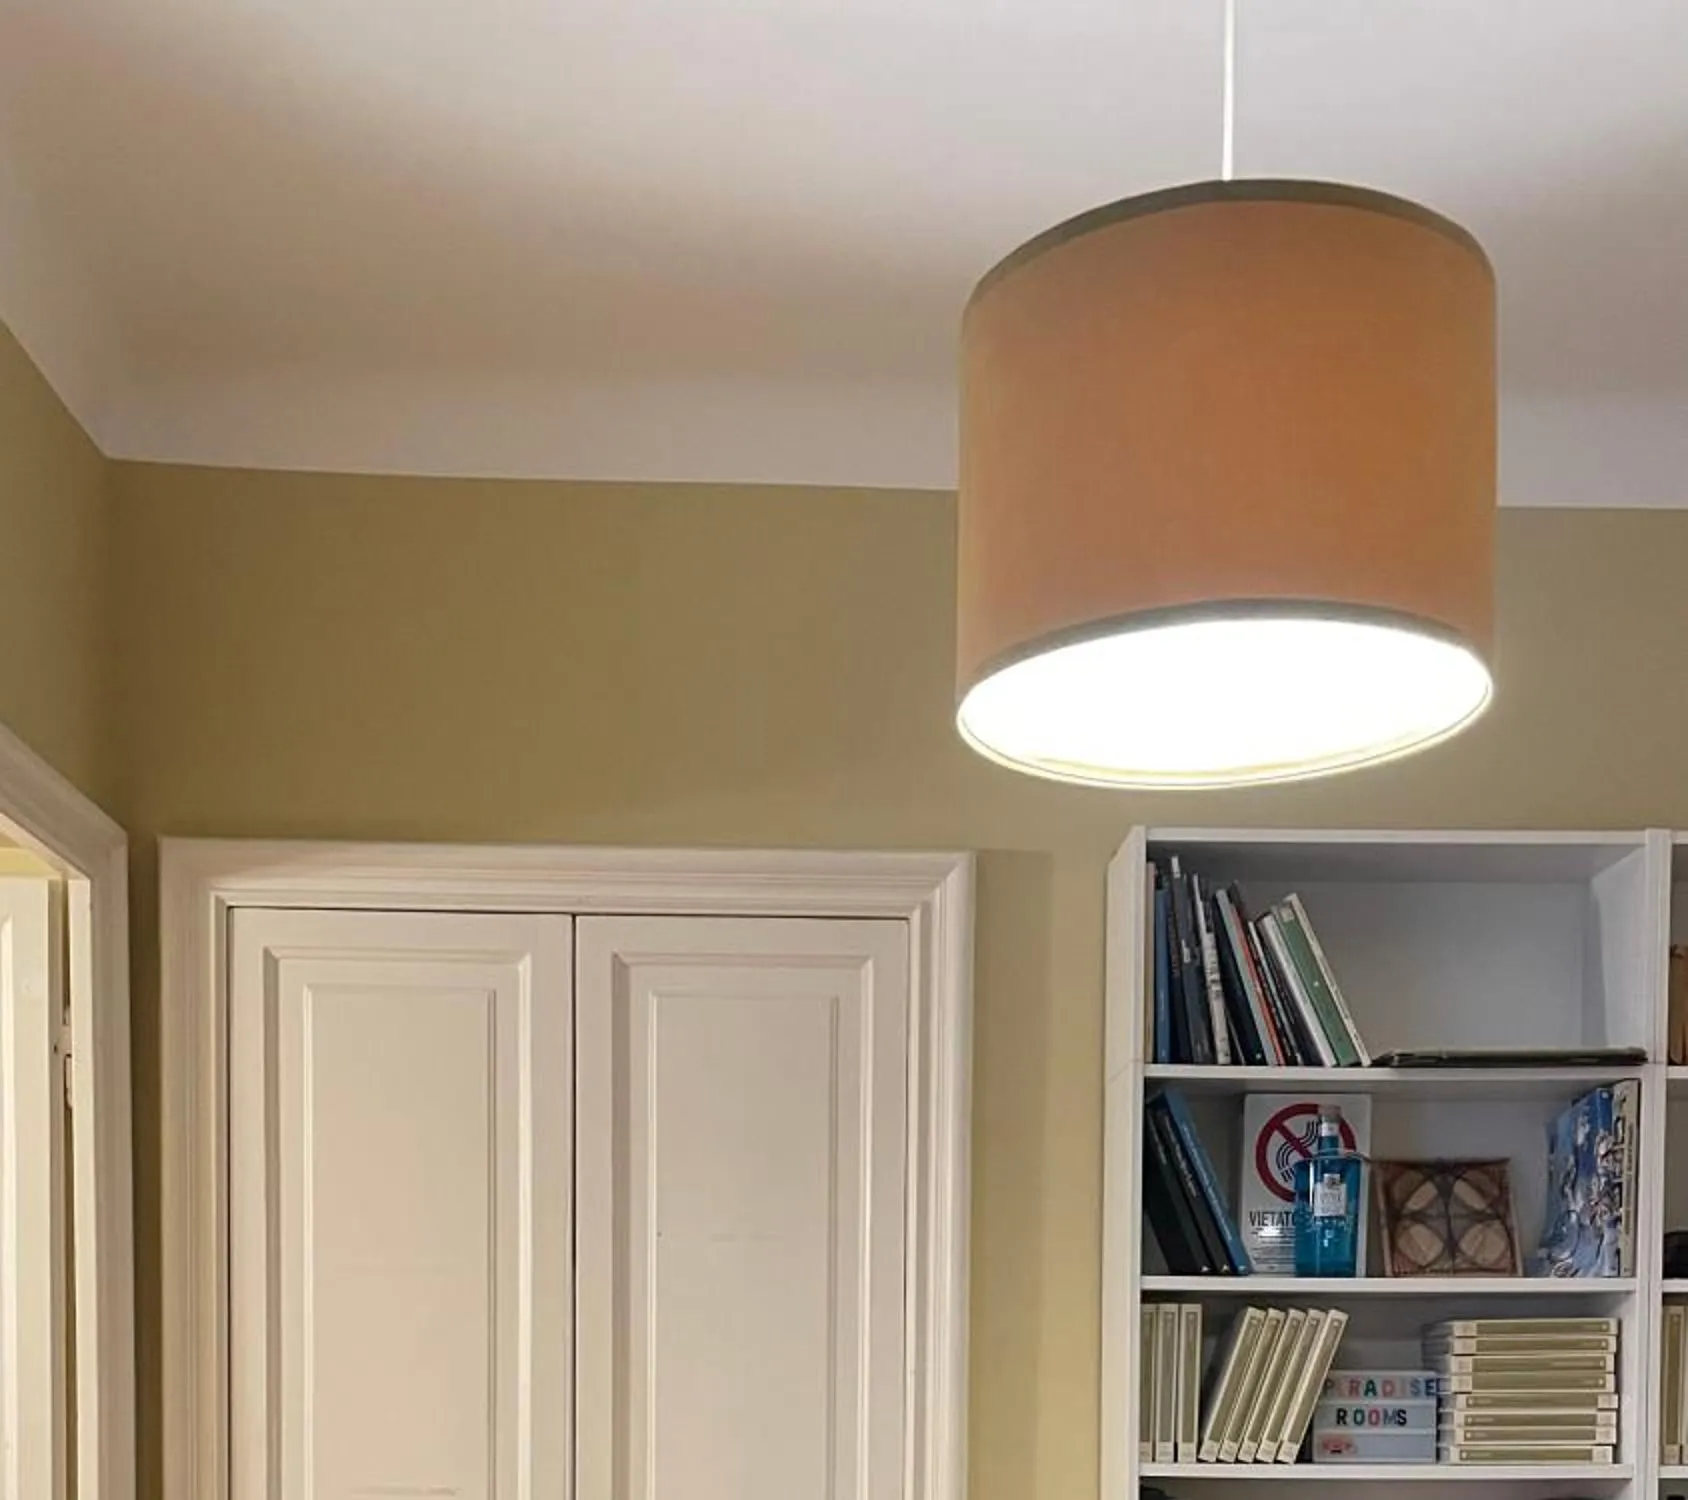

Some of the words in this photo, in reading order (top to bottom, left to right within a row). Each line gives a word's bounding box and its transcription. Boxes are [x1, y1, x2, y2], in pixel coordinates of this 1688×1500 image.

[1249, 1211, 1296, 1227] VIETAT
[1323, 1378, 1436, 1397] PRADISE
[1337, 1408, 1407, 1426] ROOMS
